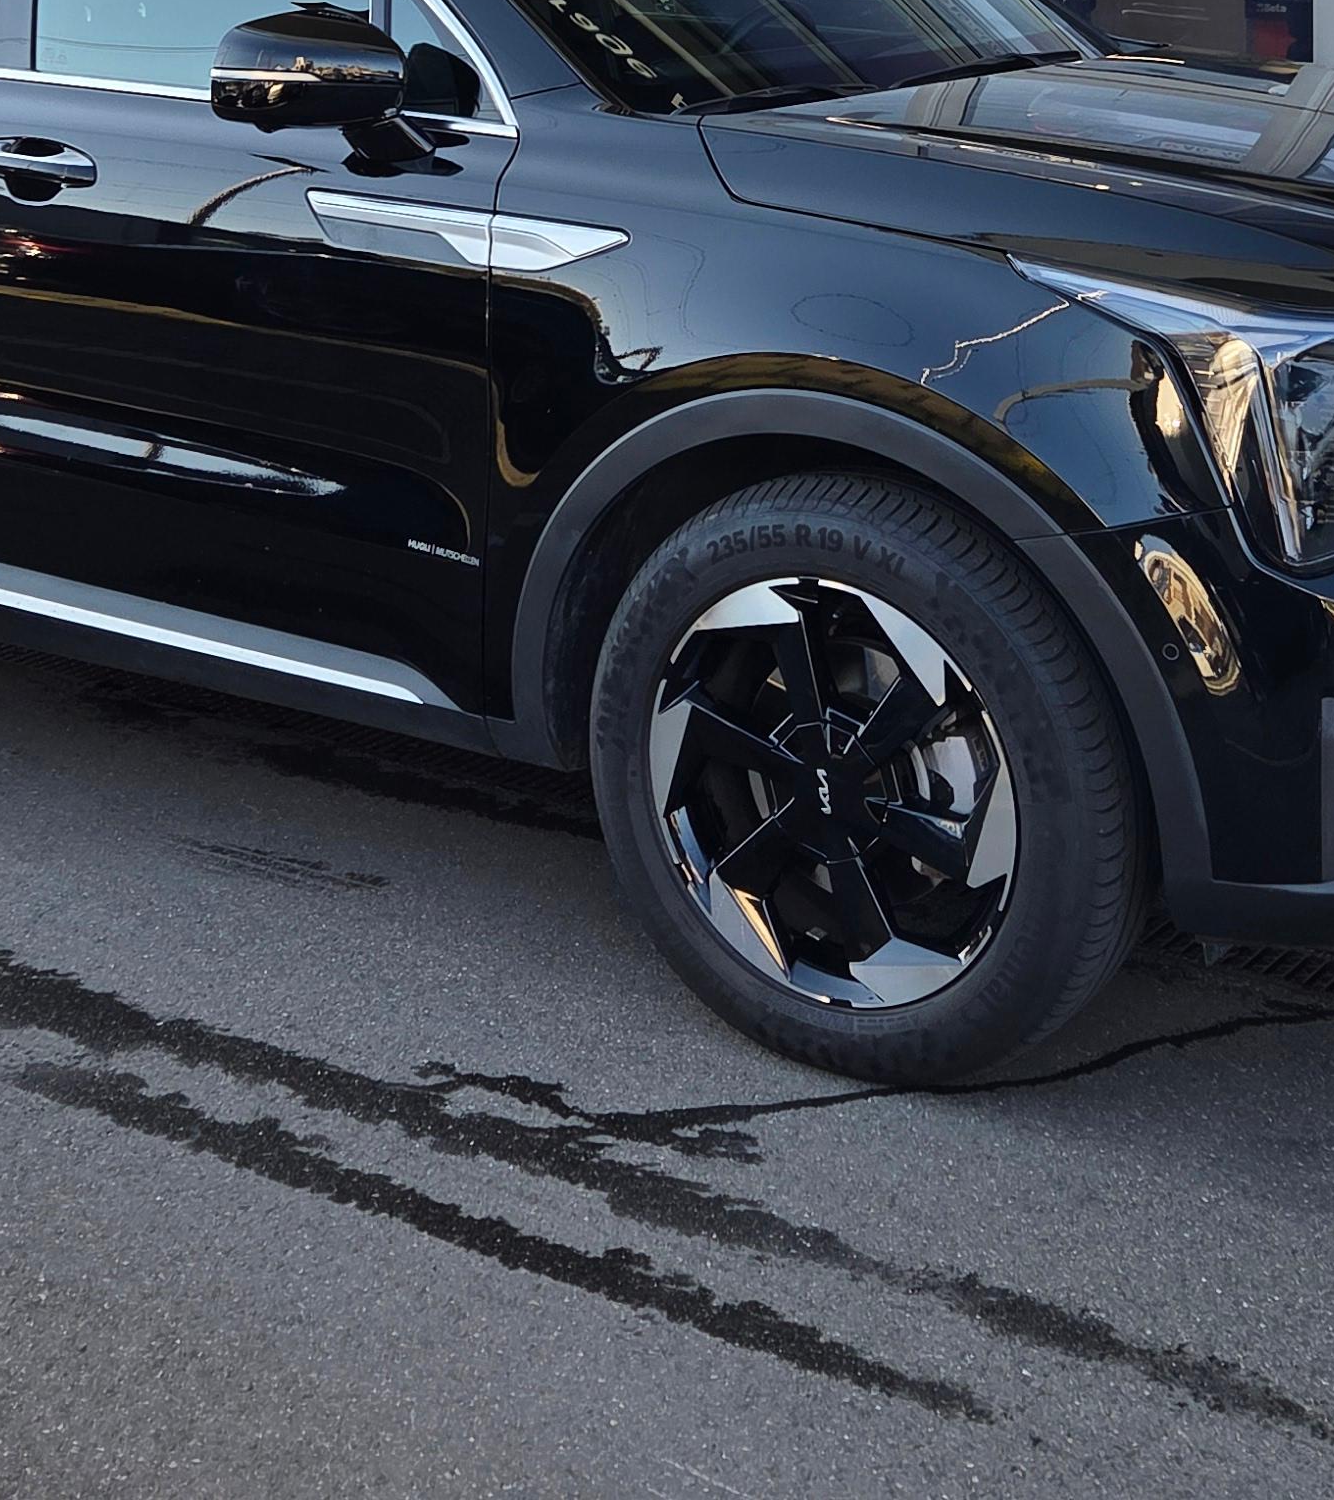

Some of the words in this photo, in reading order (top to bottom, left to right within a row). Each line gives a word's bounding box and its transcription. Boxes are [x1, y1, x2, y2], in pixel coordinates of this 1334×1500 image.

[706, 523, 786, 565] 235/55
[794, 523, 812, 549] R
[817, 526, 844, 553] 19
[853, 535, 872, 561] V
[875, 545, 907, 577] XL
